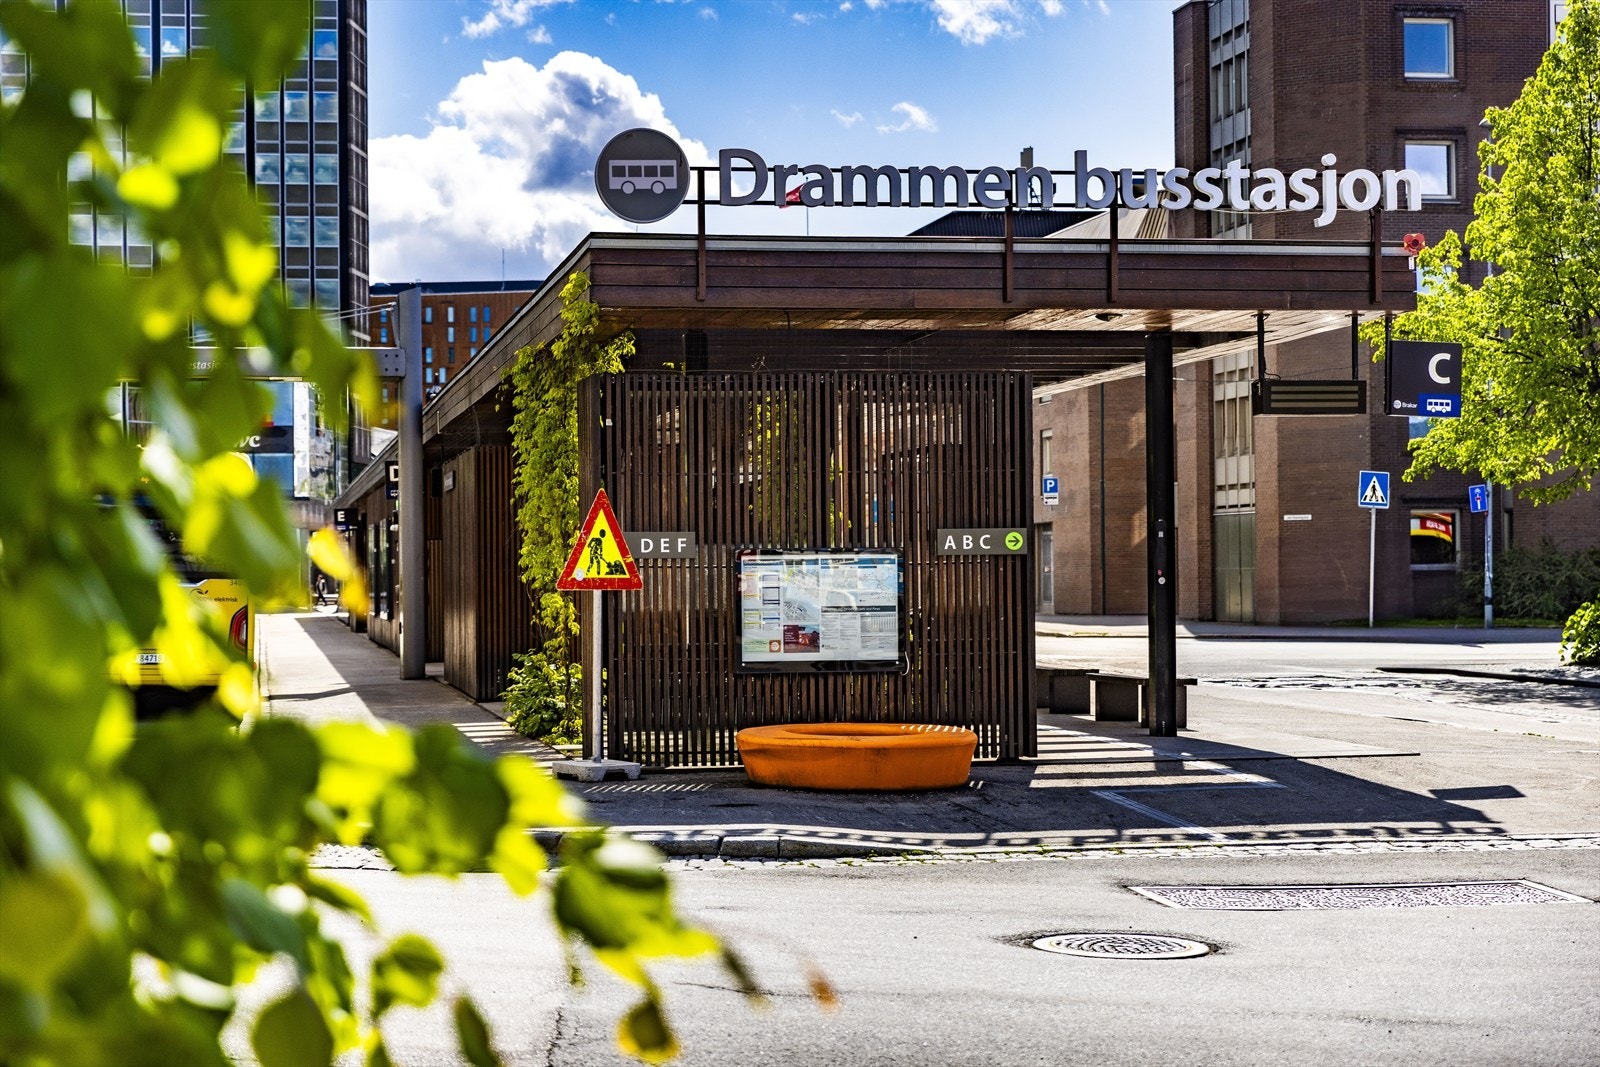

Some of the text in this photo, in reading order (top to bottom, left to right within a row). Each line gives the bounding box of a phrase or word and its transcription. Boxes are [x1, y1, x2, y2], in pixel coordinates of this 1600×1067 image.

[719, 148, 1422, 228] Drammen busstasjon
[1428, 353, 1451, 384] C
[1047, 479, 1055, 491] P
[337, 511, 346, 521] E
